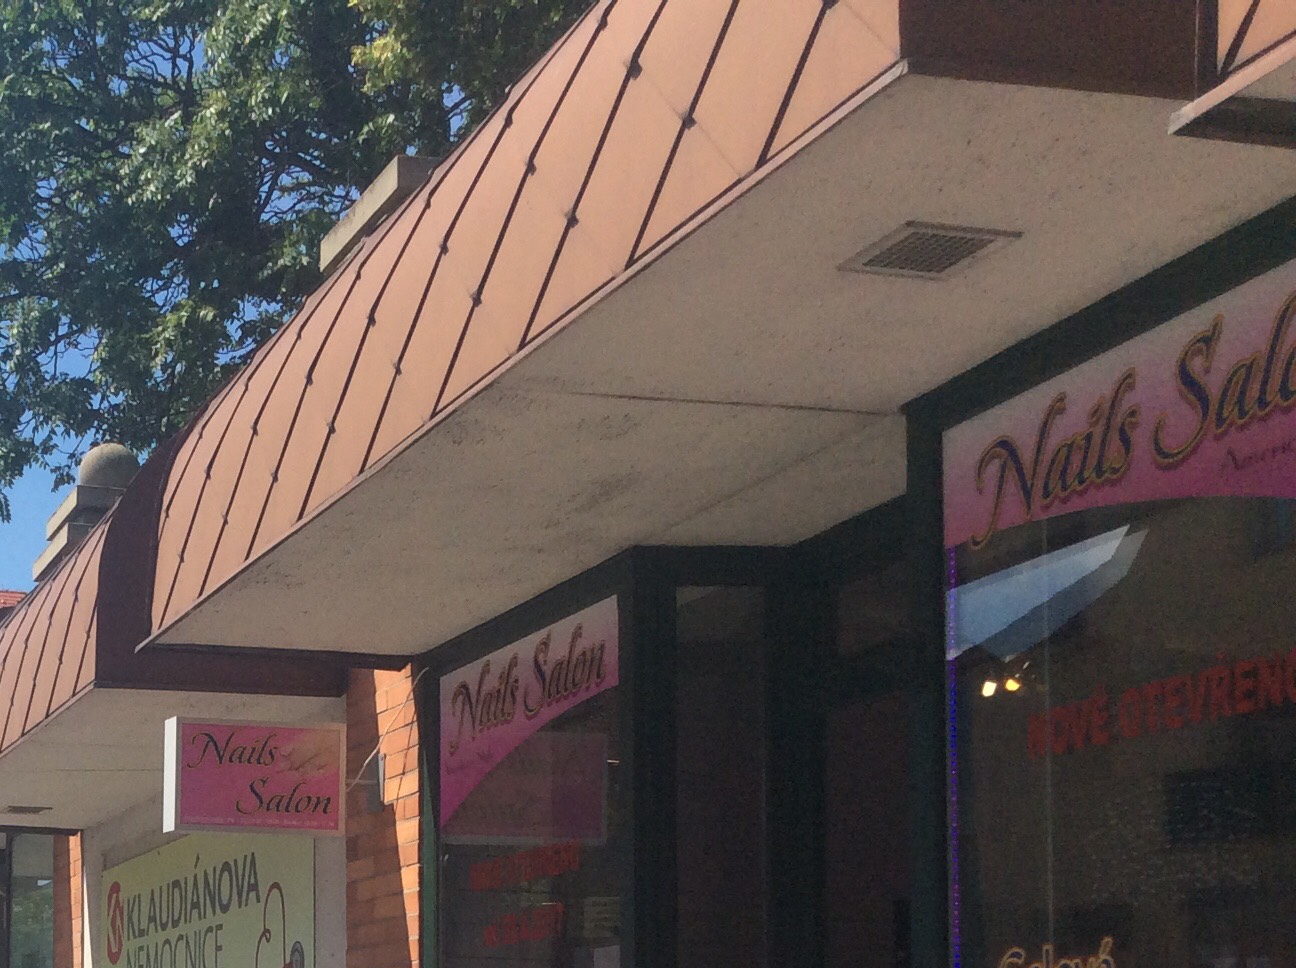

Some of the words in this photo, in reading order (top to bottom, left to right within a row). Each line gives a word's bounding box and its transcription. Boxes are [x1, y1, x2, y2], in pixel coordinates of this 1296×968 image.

[969, 367, 1141, 551] Nails
[449, 652, 519, 757] Nails
[524, 623, 606, 720] Salon
[186, 731, 278, 768] Nails
[235, 776, 332, 815] Salon
[126, 852, 261, 942] KLAUDIÁNOVA
